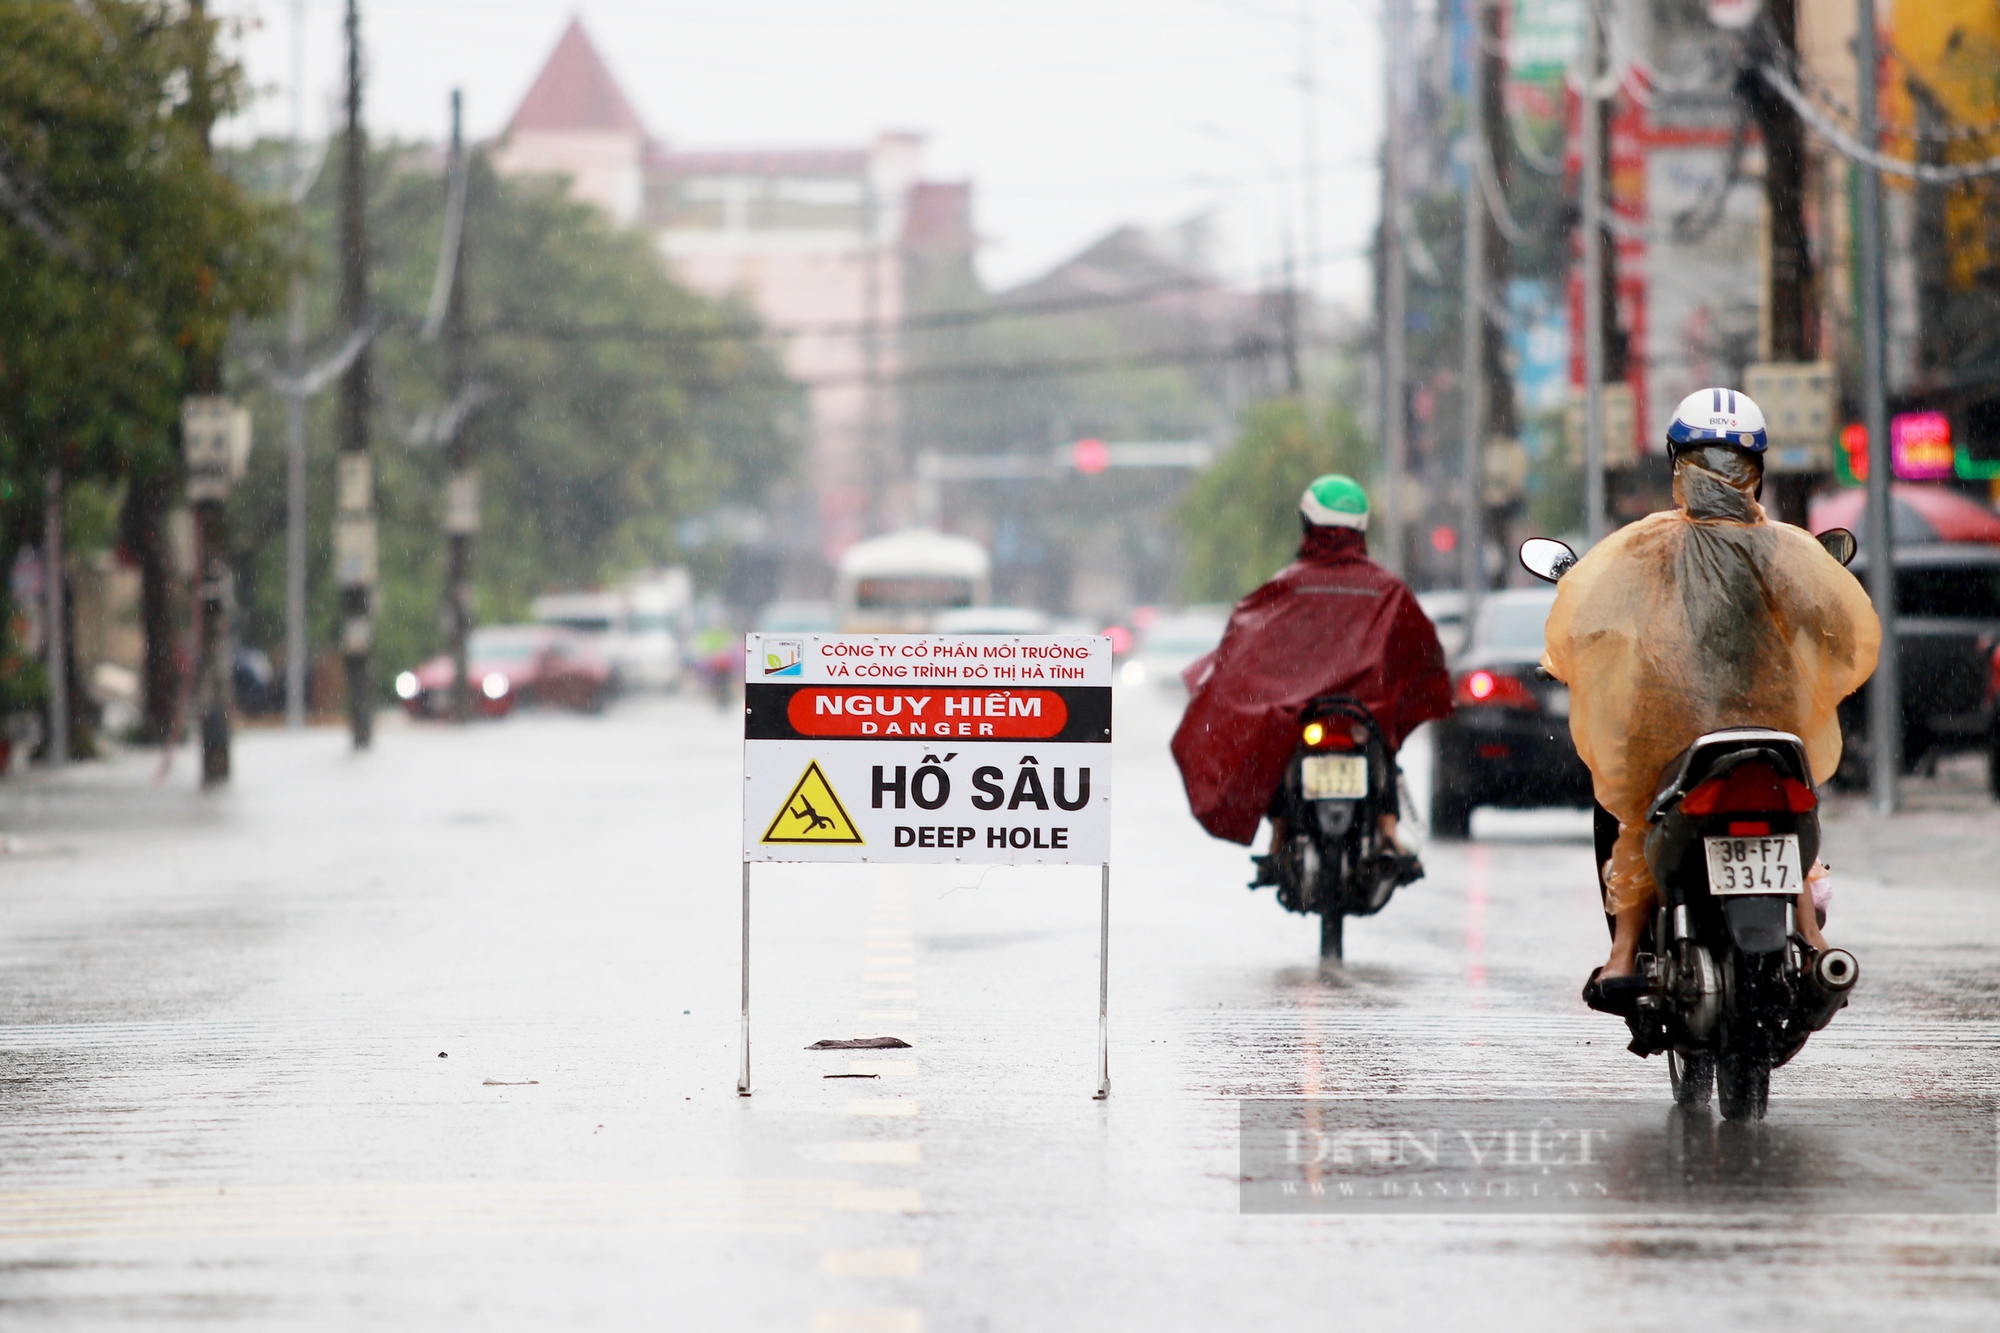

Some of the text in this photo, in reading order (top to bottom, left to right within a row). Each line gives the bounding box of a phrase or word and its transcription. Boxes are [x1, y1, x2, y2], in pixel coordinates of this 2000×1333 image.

[1709, 417, 1729, 425] BIDV
[821, 640, 1089, 659] CÔNG TY CỔ PHẦN MÔI TRƯỜNG
[826, 661, 1084, 681] VÀ CÔNG TRÌNH ĐÔ THỊ HÀ TĨNH
[815, 691, 1042, 717] NGUY HIỂM
[861, 721, 994, 736] DANGER
[871, 752, 1091, 811] HỐ SÂU
[894, 826, 1068, 849] DEEP HOLE
[1720, 838, 1785, 862] 38-F7
[1724, 865, 1788, 889] 3347
